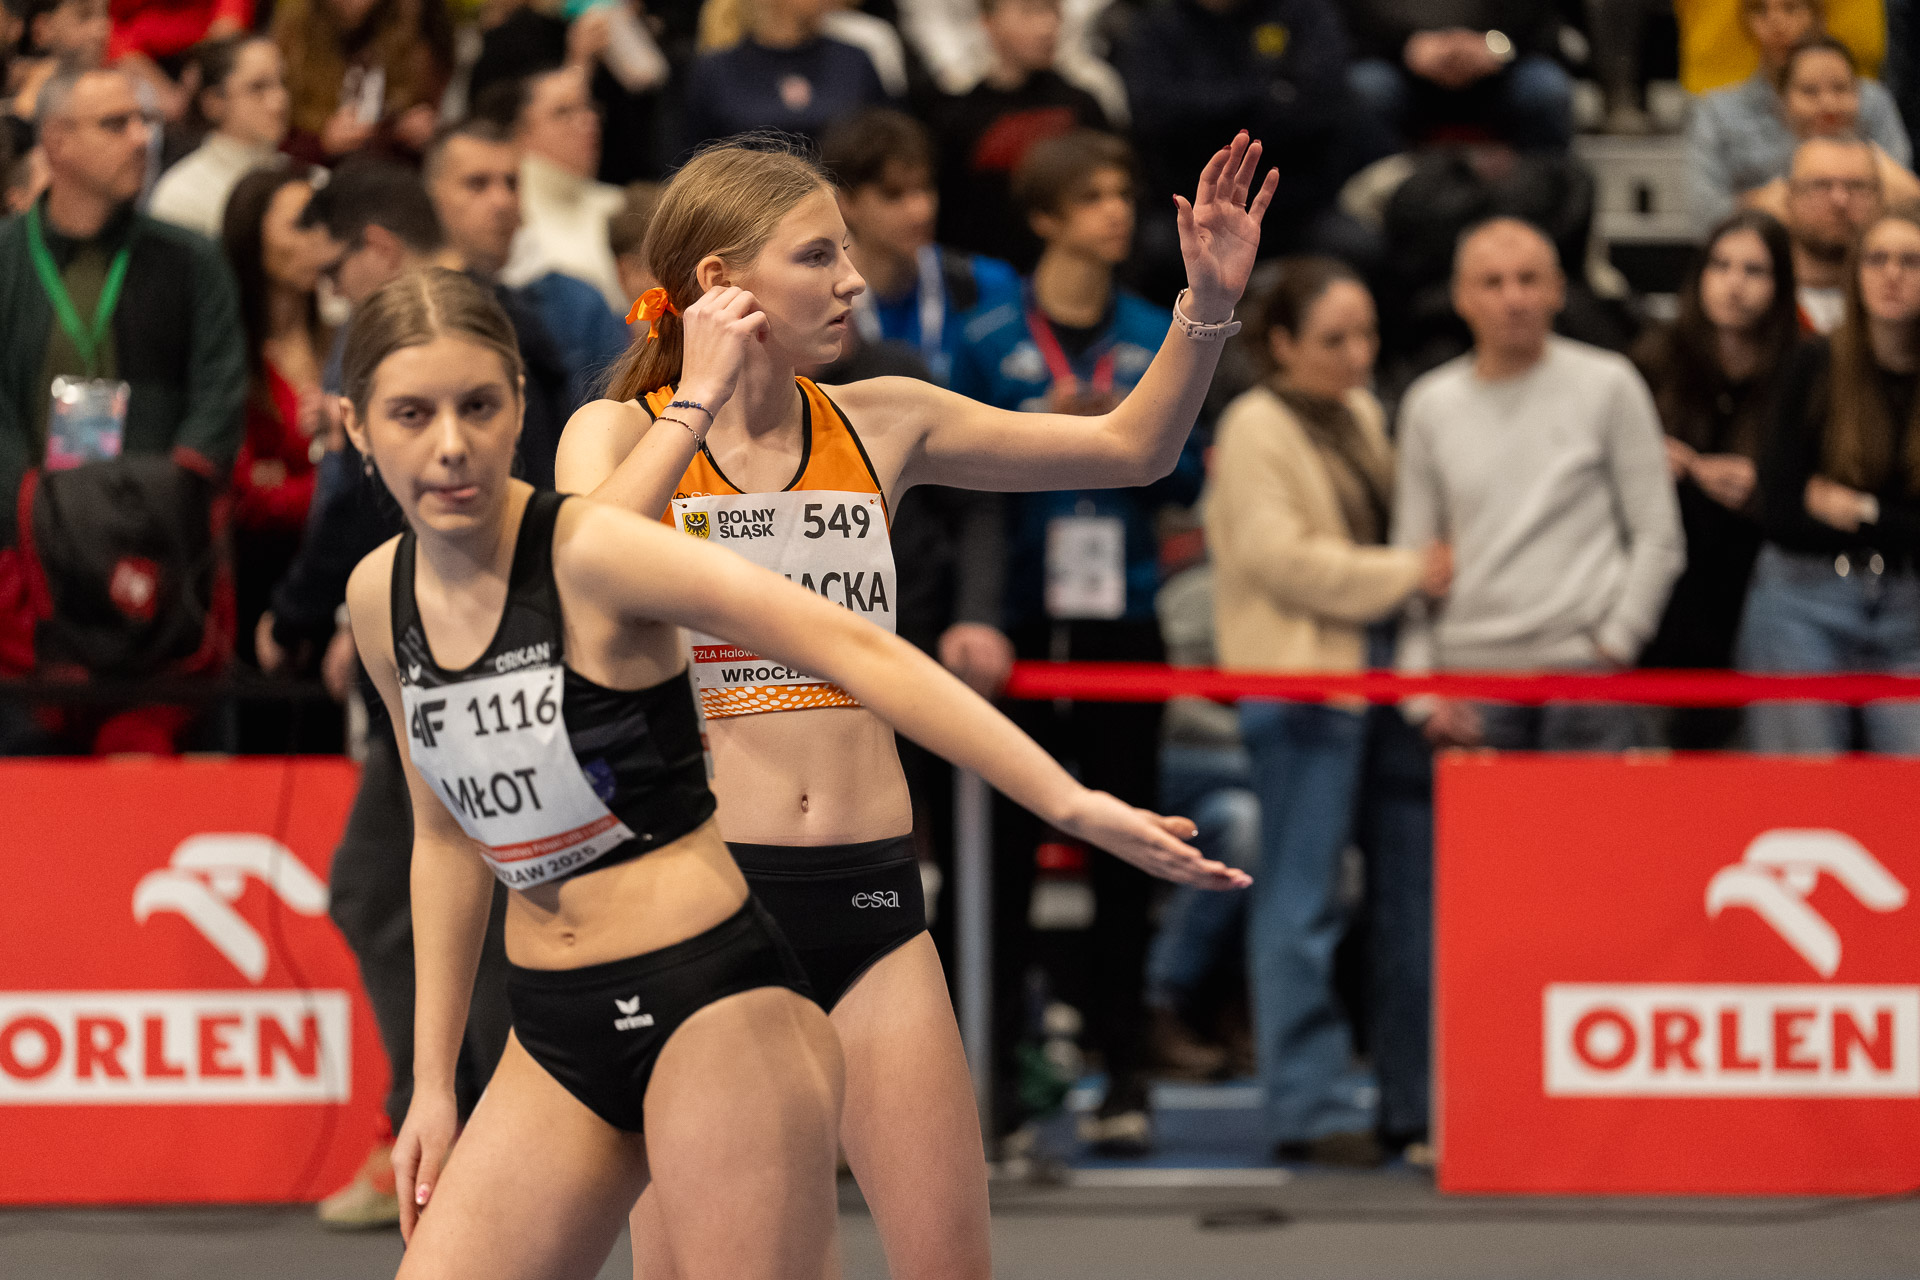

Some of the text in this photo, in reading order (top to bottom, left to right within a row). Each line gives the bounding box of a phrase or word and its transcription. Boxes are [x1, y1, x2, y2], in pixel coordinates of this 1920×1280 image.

[717, 508, 776, 524] DOLNY
[719, 522, 775, 540] ŚLĄSK
[803, 503, 871, 539] 549
[784, 571, 889, 612] ACKA
[721, 666, 810, 683] WROCŁA
[467, 685, 557, 736] 1116
[441, 767, 543, 820] MŁOT
[0, 1014, 319, 1080] ORLEN
[1571, 1007, 1894, 1072] ORLEN
